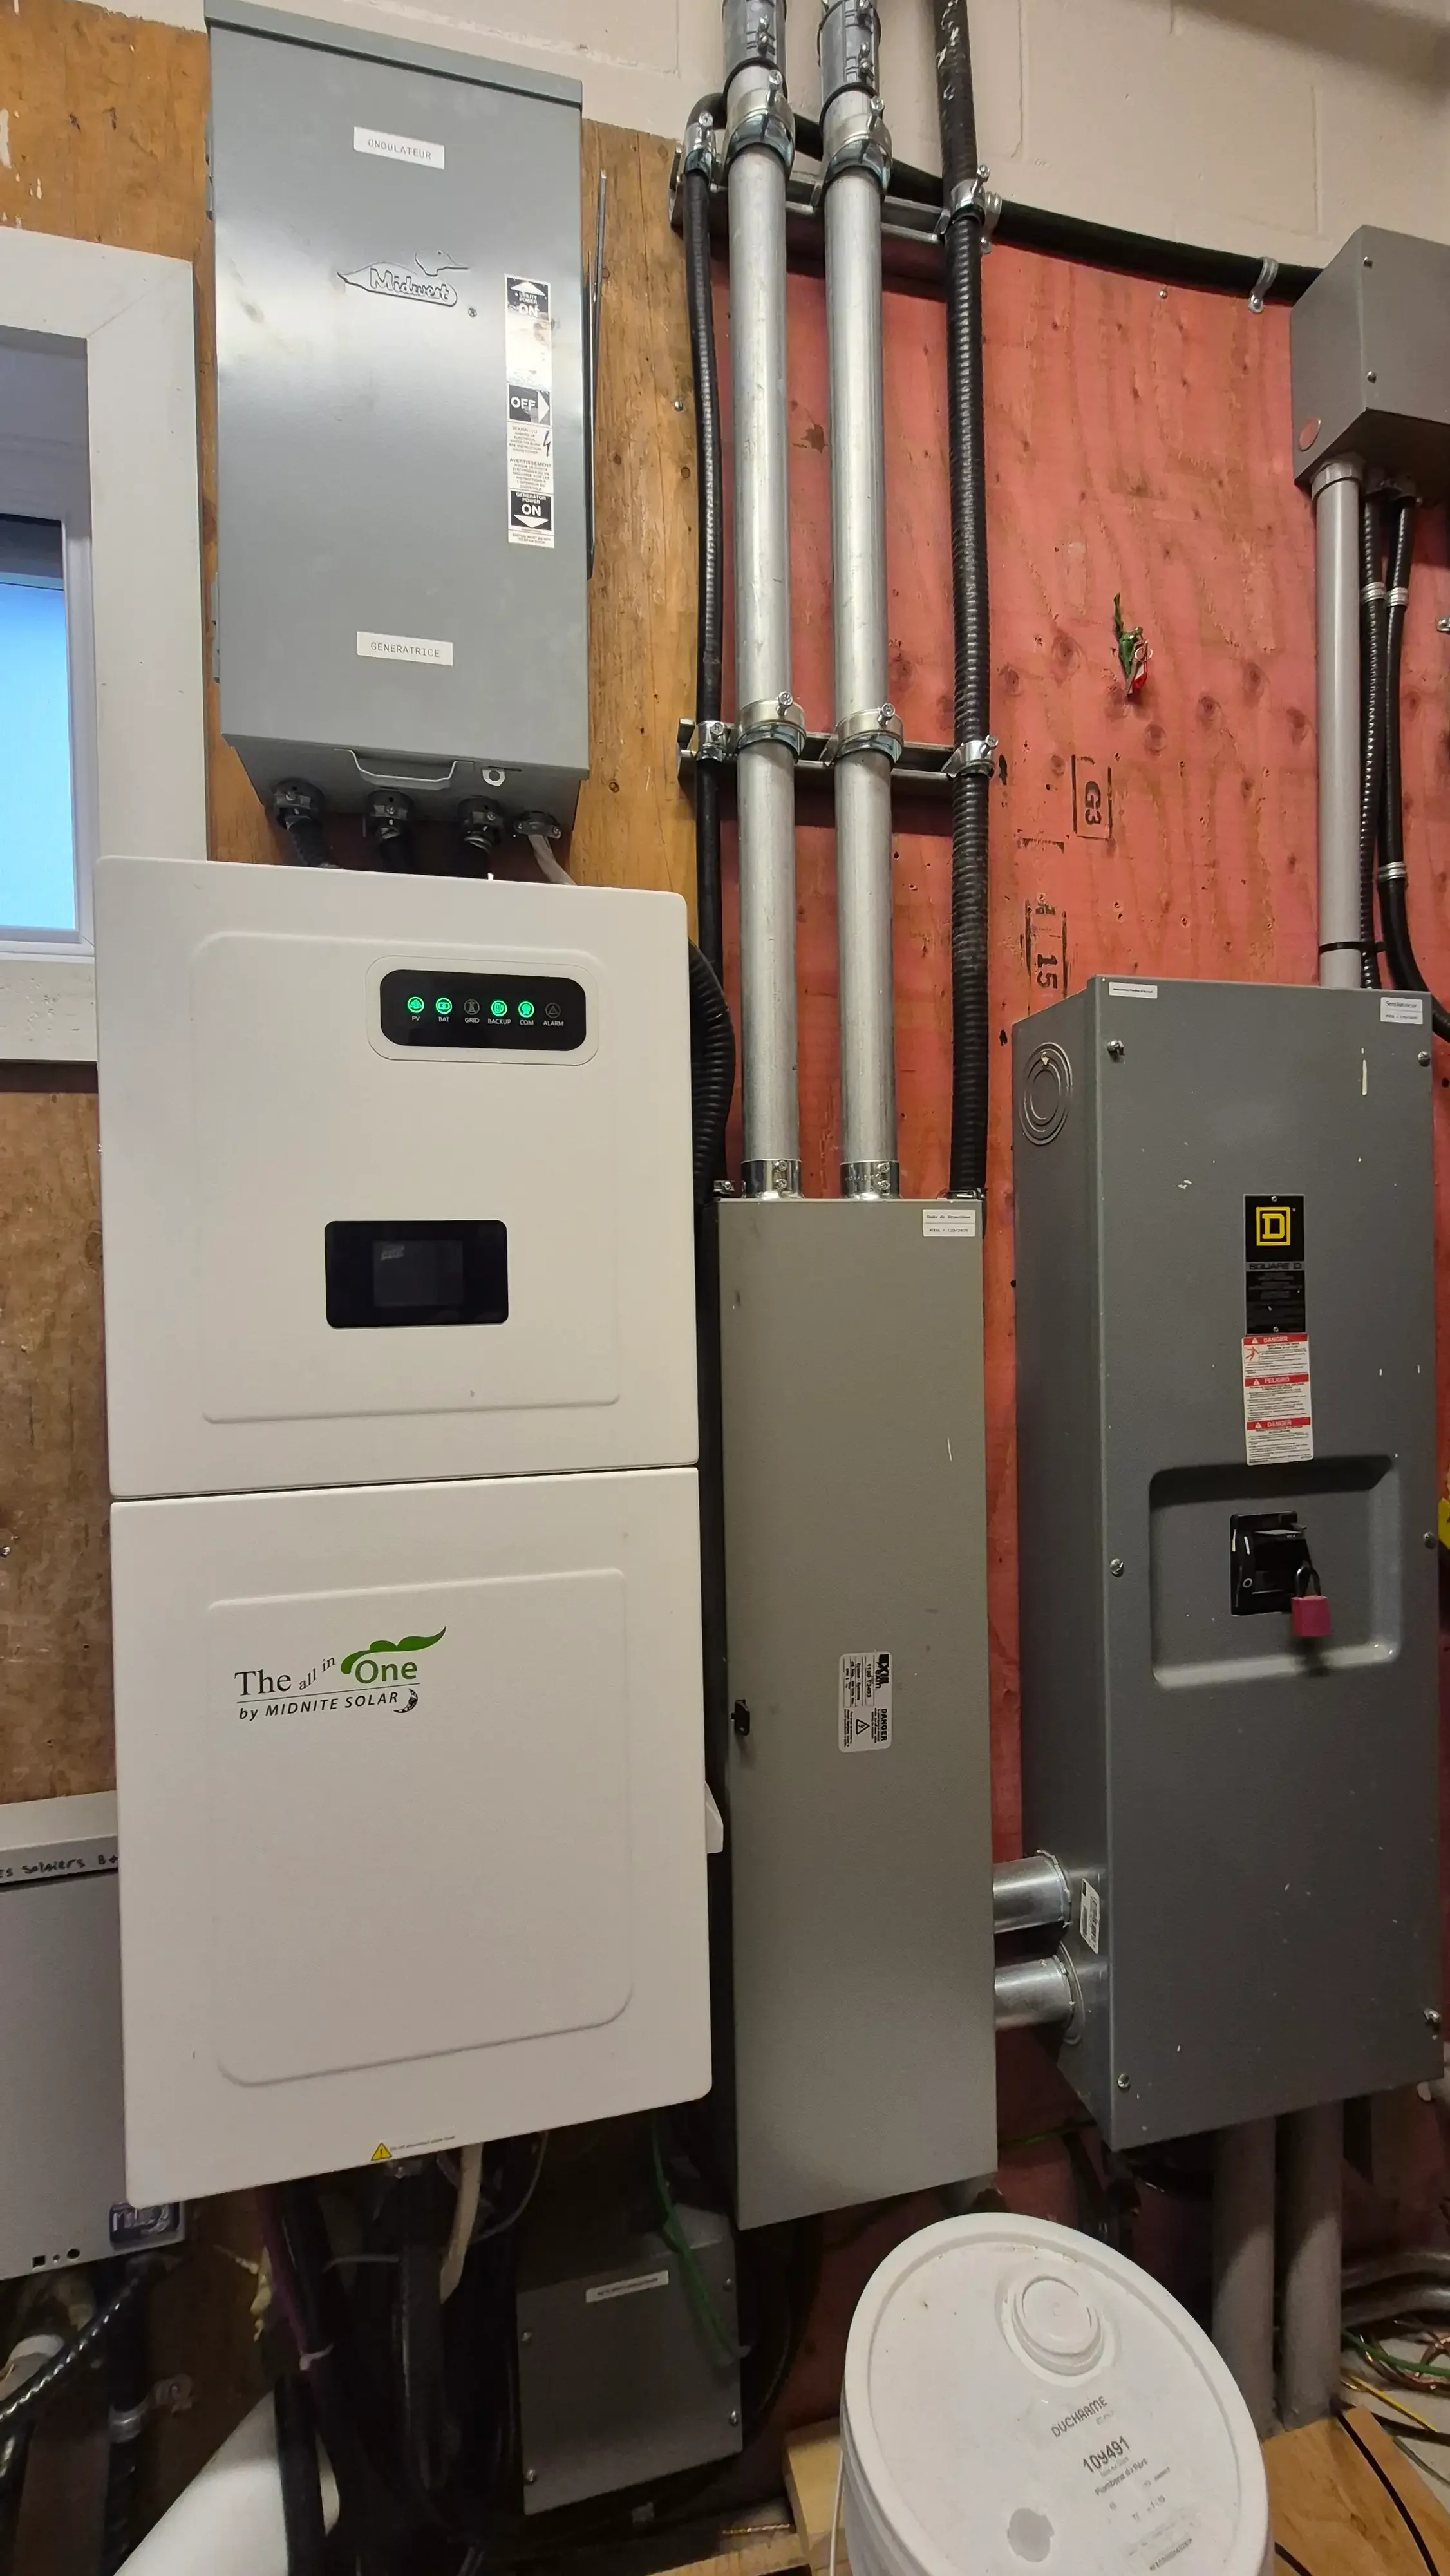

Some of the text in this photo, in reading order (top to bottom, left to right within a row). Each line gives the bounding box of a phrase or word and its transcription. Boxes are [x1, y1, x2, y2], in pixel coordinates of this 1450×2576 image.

[367, 138, 431, 160] ONDULATEUR
[370, 267, 449, 301] Midwest
[518, 303, 540, 317] ON
[511, 397, 536, 410] OFF
[510, 458, 551, 468] AVERTISSEMENT
[516, 492, 546, 500] GENERATOR
[522, 504, 541, 516] ON
[371, 642, 440, 658] GENERATRICE
[1085, 781, 1102, 825] G3
[1037, 954, 1058, 989] 15
[1262, 1213, 1285, 1239] D
[1267, 1419, 1292, 1428] DANGER
[234, 1656, 418, 1696] The all in One
[239, 1692, 399, 1721] by MIDNITE SOLAR
[1051, 2395, 1107, 2438] DUCHARME
